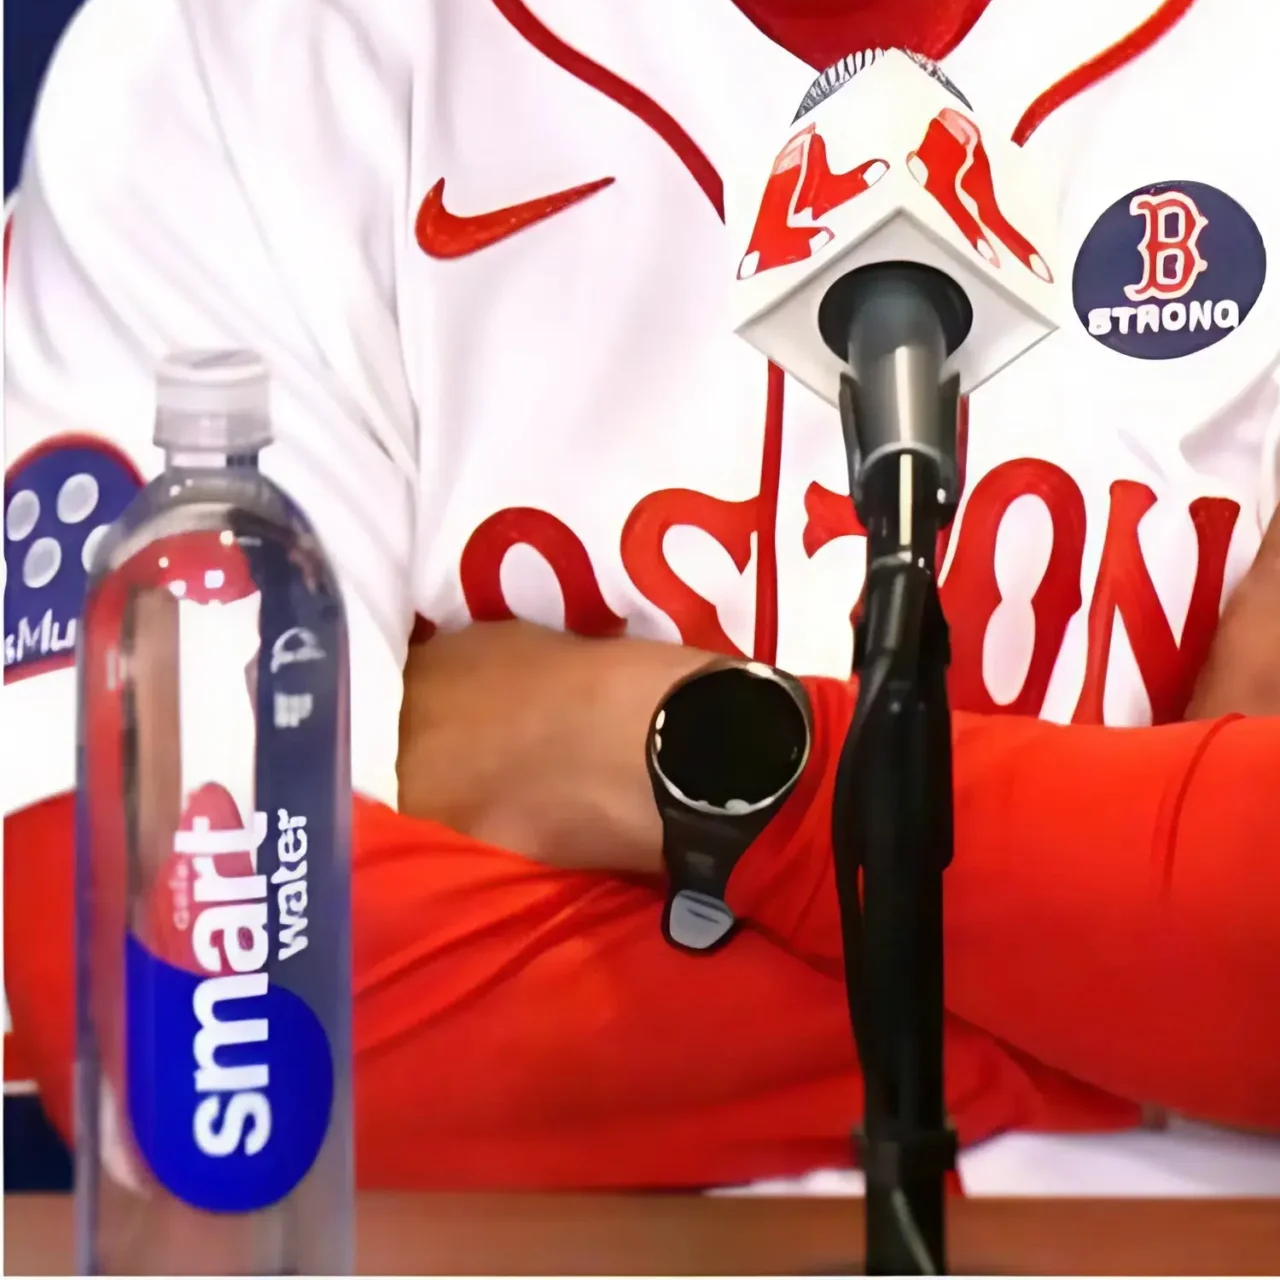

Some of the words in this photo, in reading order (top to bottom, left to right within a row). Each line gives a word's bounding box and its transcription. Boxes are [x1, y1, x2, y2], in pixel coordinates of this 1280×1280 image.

[1123, 191, 1208, 301] B
[1088, 299, 1239, 335] STRONG
[271, 808, 309, 961] water
[173, 810, 272, 1157] smart
